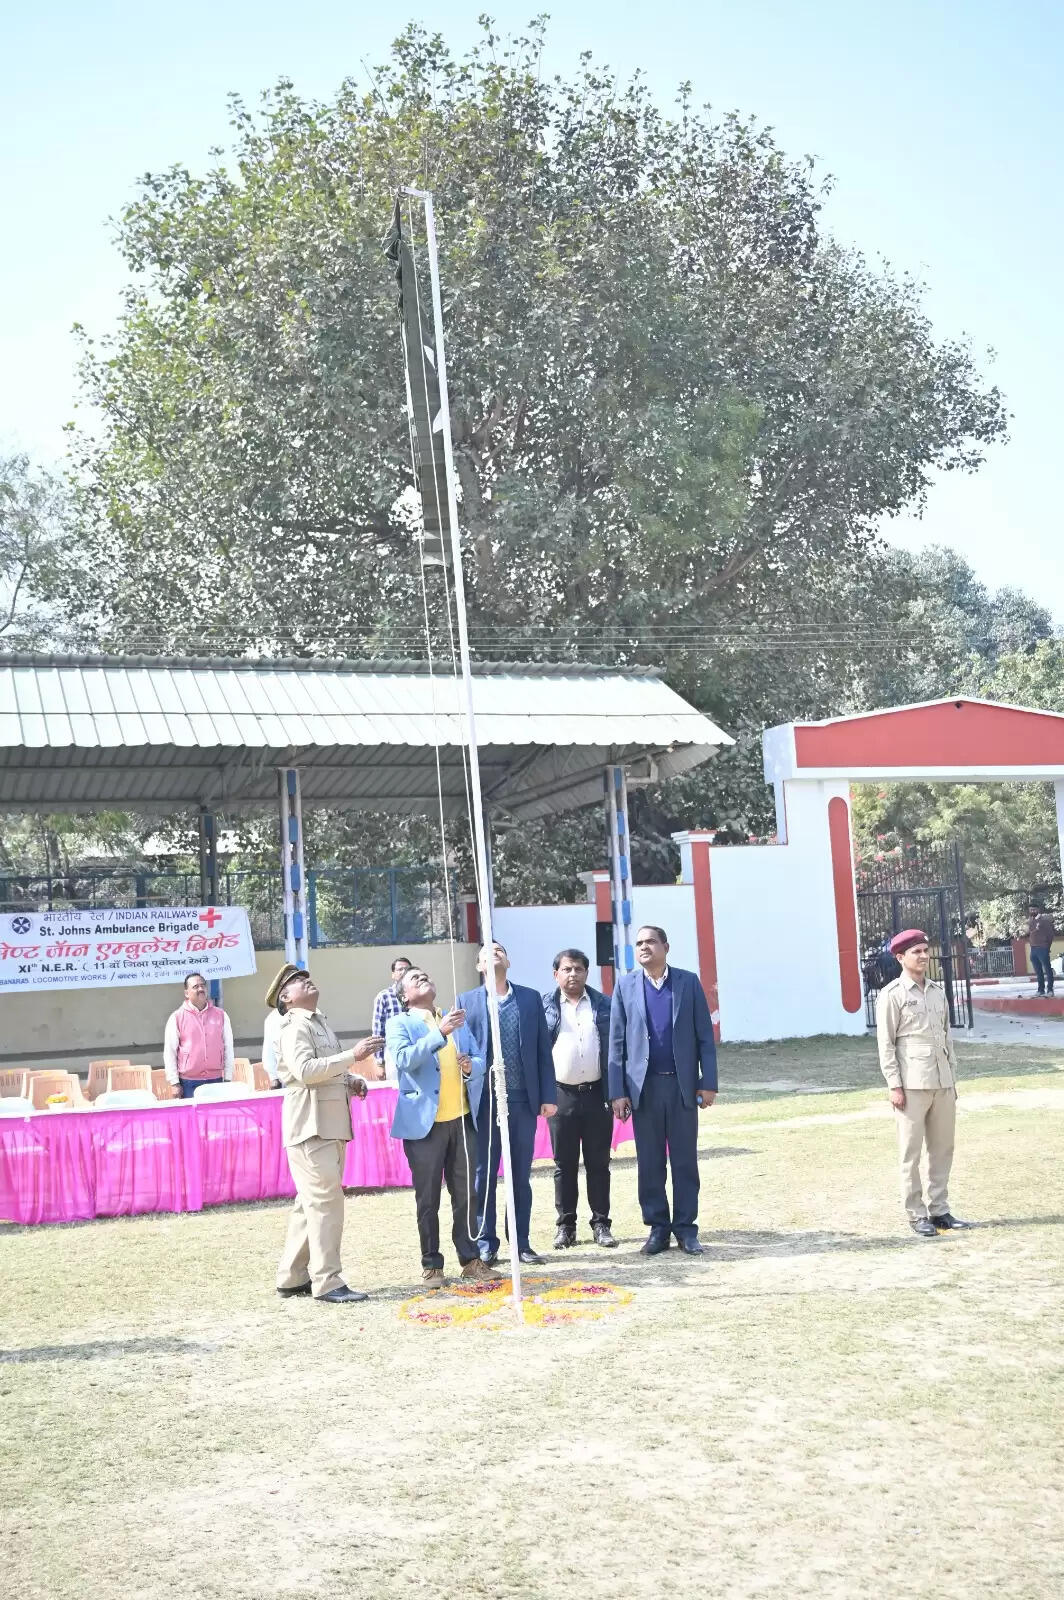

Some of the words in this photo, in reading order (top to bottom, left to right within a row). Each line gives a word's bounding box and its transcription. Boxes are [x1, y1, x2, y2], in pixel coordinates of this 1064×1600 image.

[44, 912, 82, 922] भारतीय
[90, 911, 105, 920] रेल
[115, 911, 148, 920] INDIAN
[151, 910, 198, 920] RAILWAYS
[40, 926, 55, 936] St.
[58, 925, 91, 936] Johns
[94, 923, 155, 935] Ambulance
[158, 922, 199, 934] Brigade
[96, 936, 181, 961] एम्बुलेंस
[186, 932, 241, 952] ब्रिगेड
[41, 963, 78, 972] N.E.R.
[94, 962, 105, 970] 11
[33, 975, 79, 984] LOCOMOTIVE
